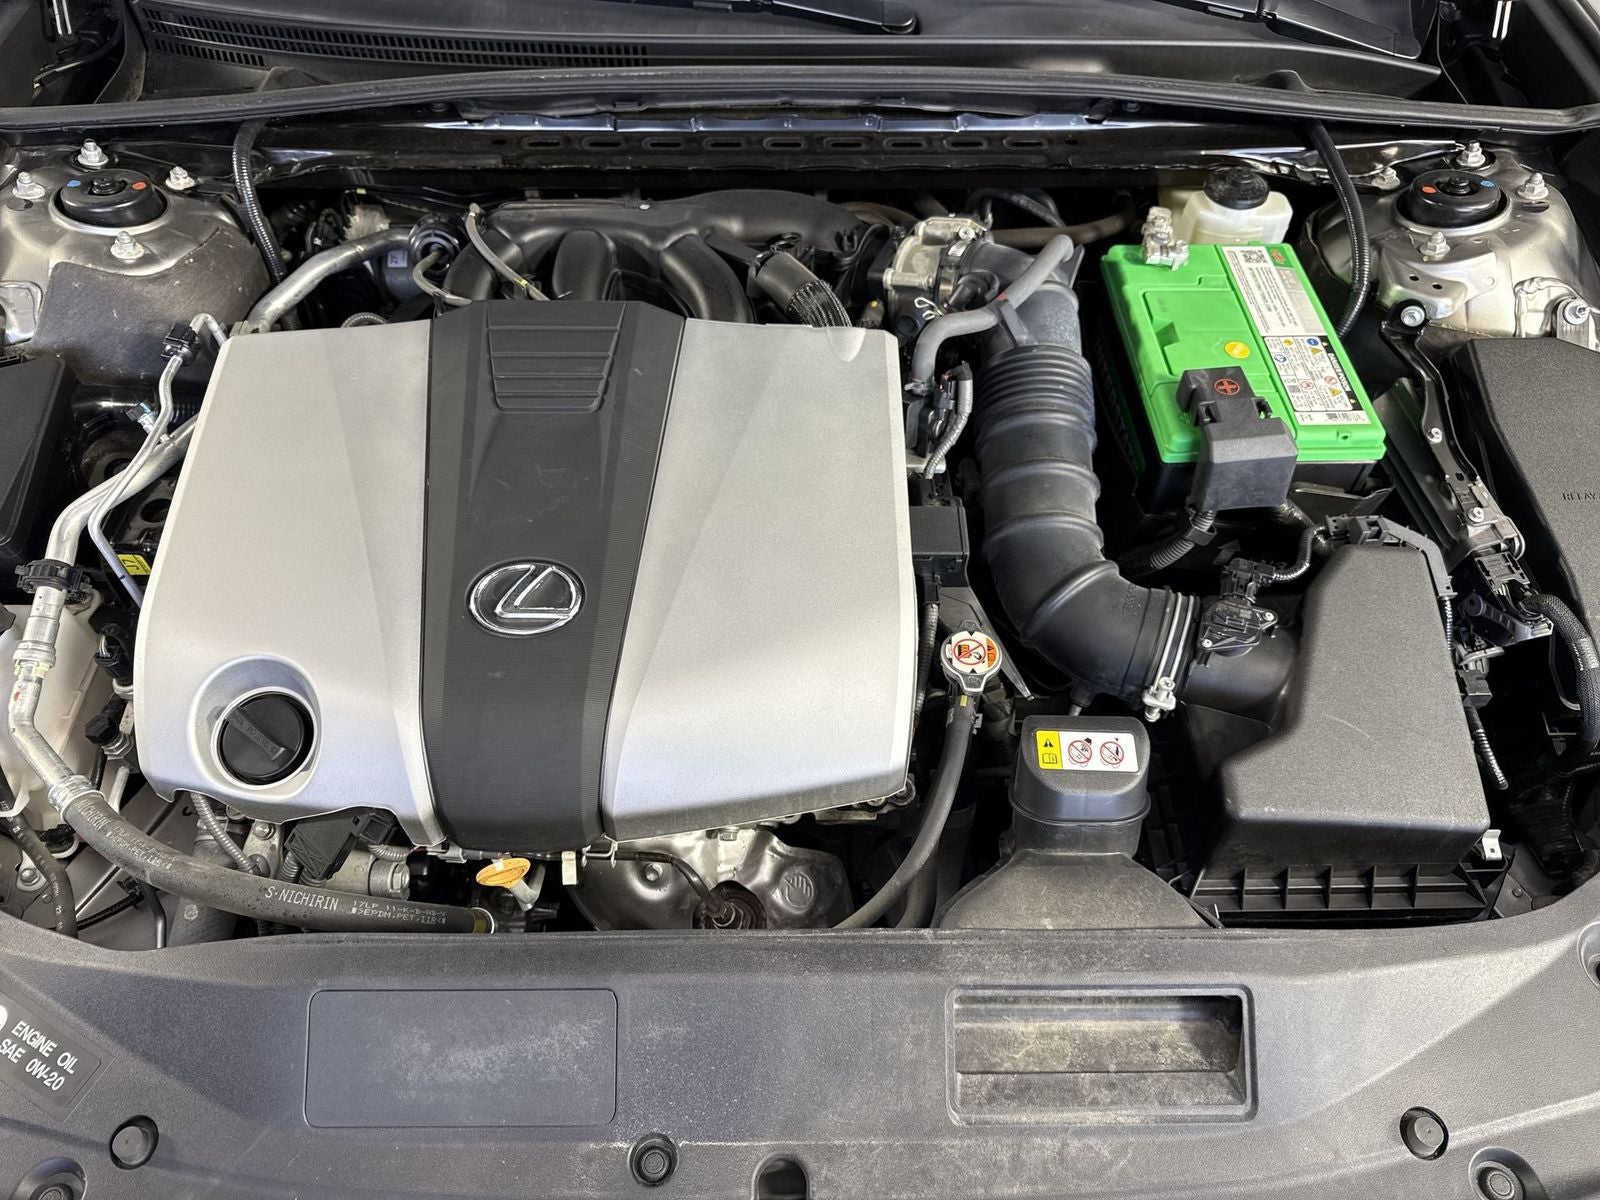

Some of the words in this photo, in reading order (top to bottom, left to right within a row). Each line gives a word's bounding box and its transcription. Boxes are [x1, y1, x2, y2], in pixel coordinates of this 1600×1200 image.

[0, 1038, 26, 1064] SAE
[25, 1058, 65, 1091] 0W-20
[11, 1020, 58, 1058] ENGINE
[57, 1051, 78, 1075] OIL
